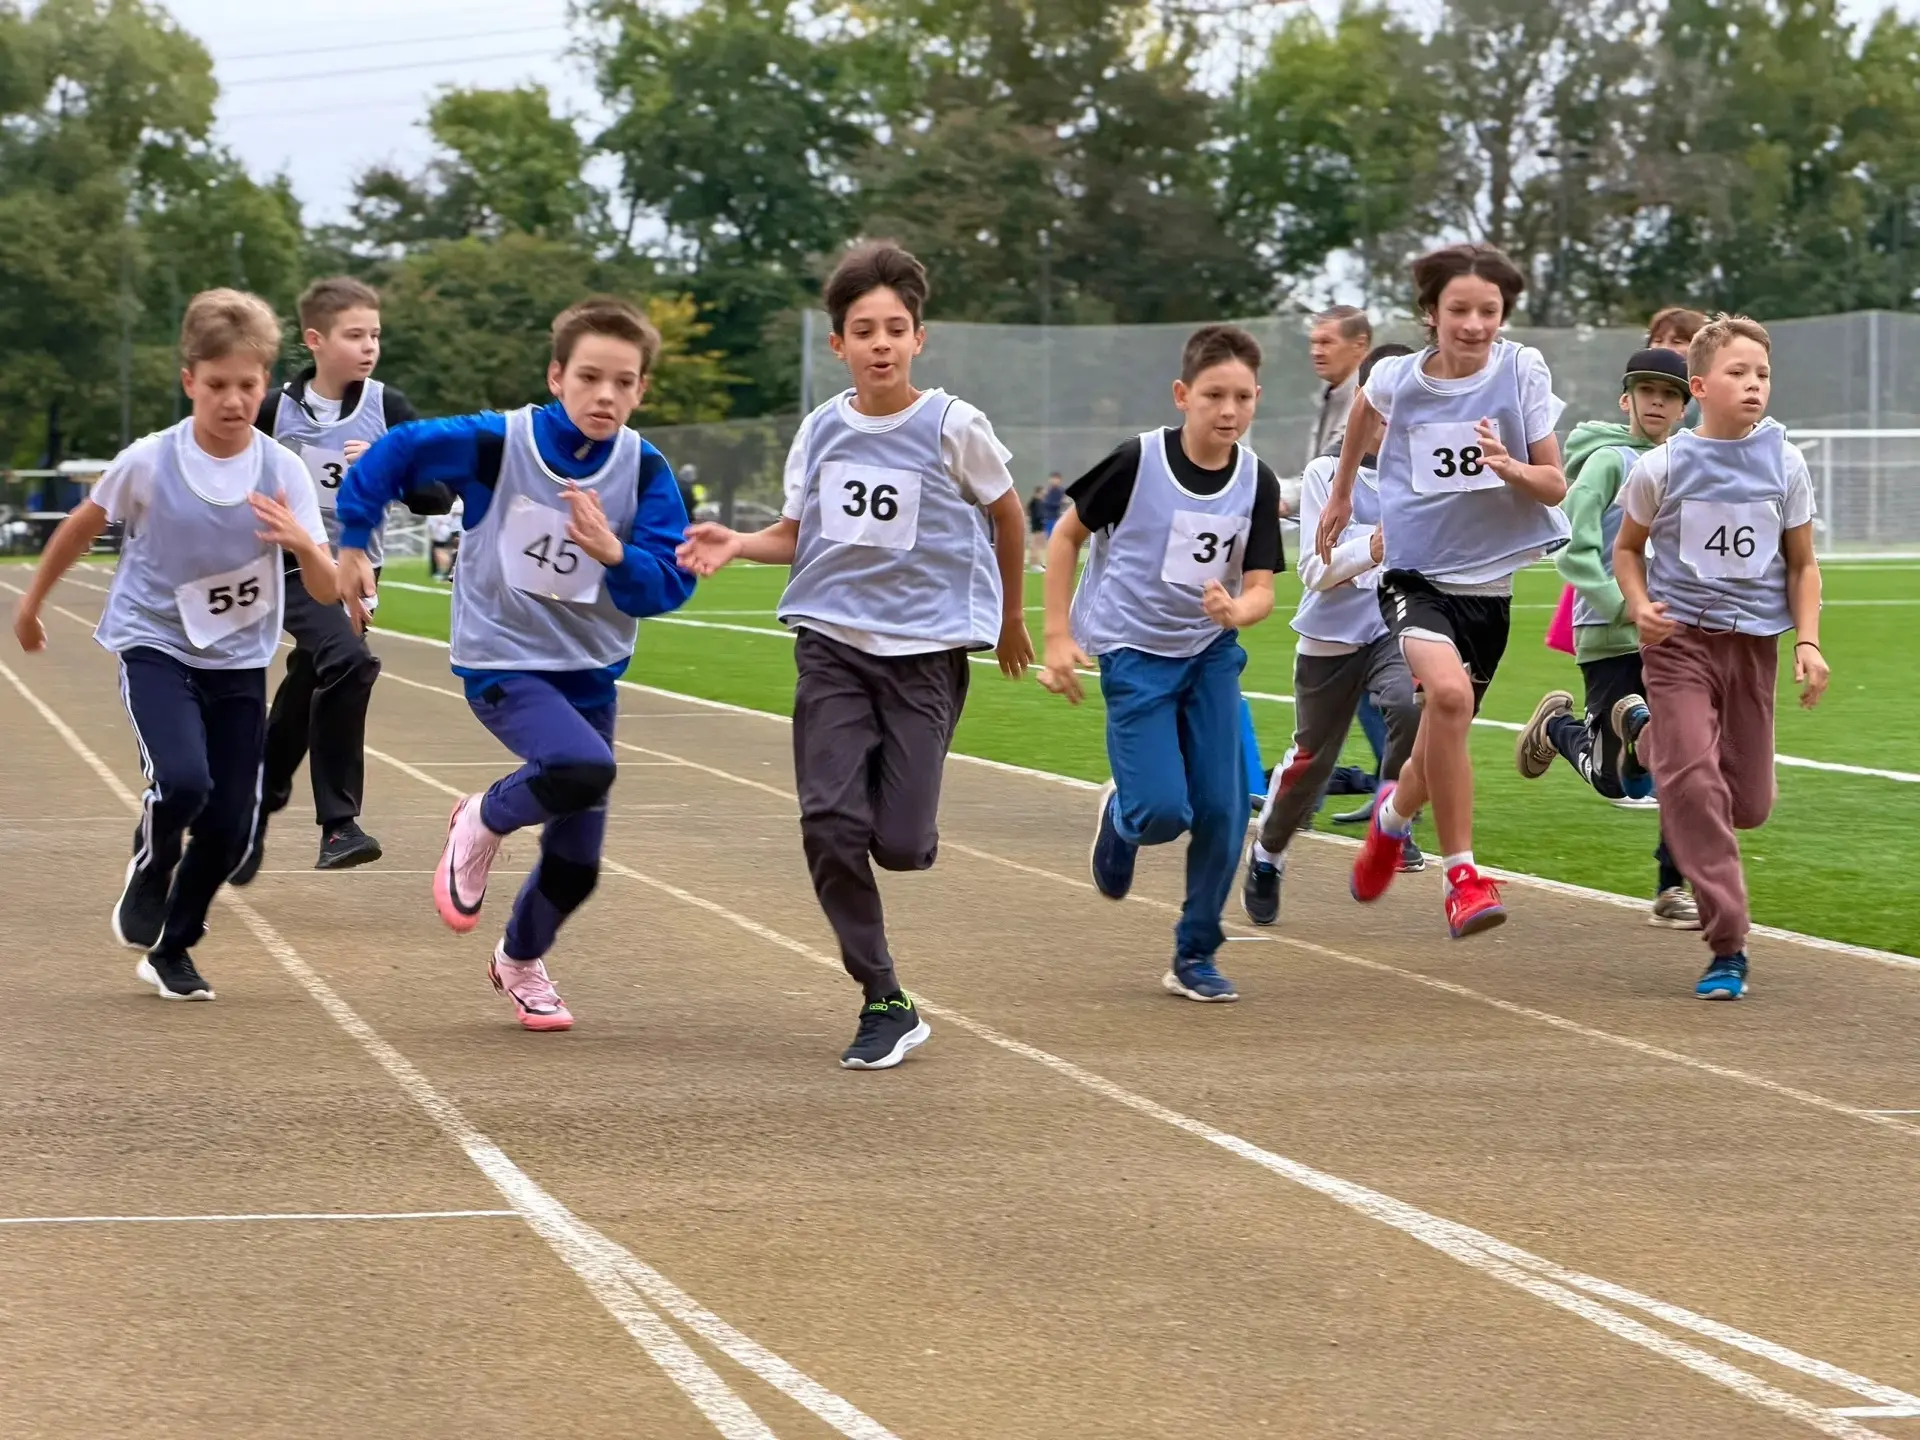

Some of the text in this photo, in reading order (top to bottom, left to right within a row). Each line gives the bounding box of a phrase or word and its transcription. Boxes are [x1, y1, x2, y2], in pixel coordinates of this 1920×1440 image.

[1432, 446, 1485, 477] 38
[842, 480, 898, 521] 36
[523, 534, 579, 575] 45
[1192, 532, 1238, 564] 31
[1704, 525, 1755, 558] 46
[208, 576, 260, 615] 55
